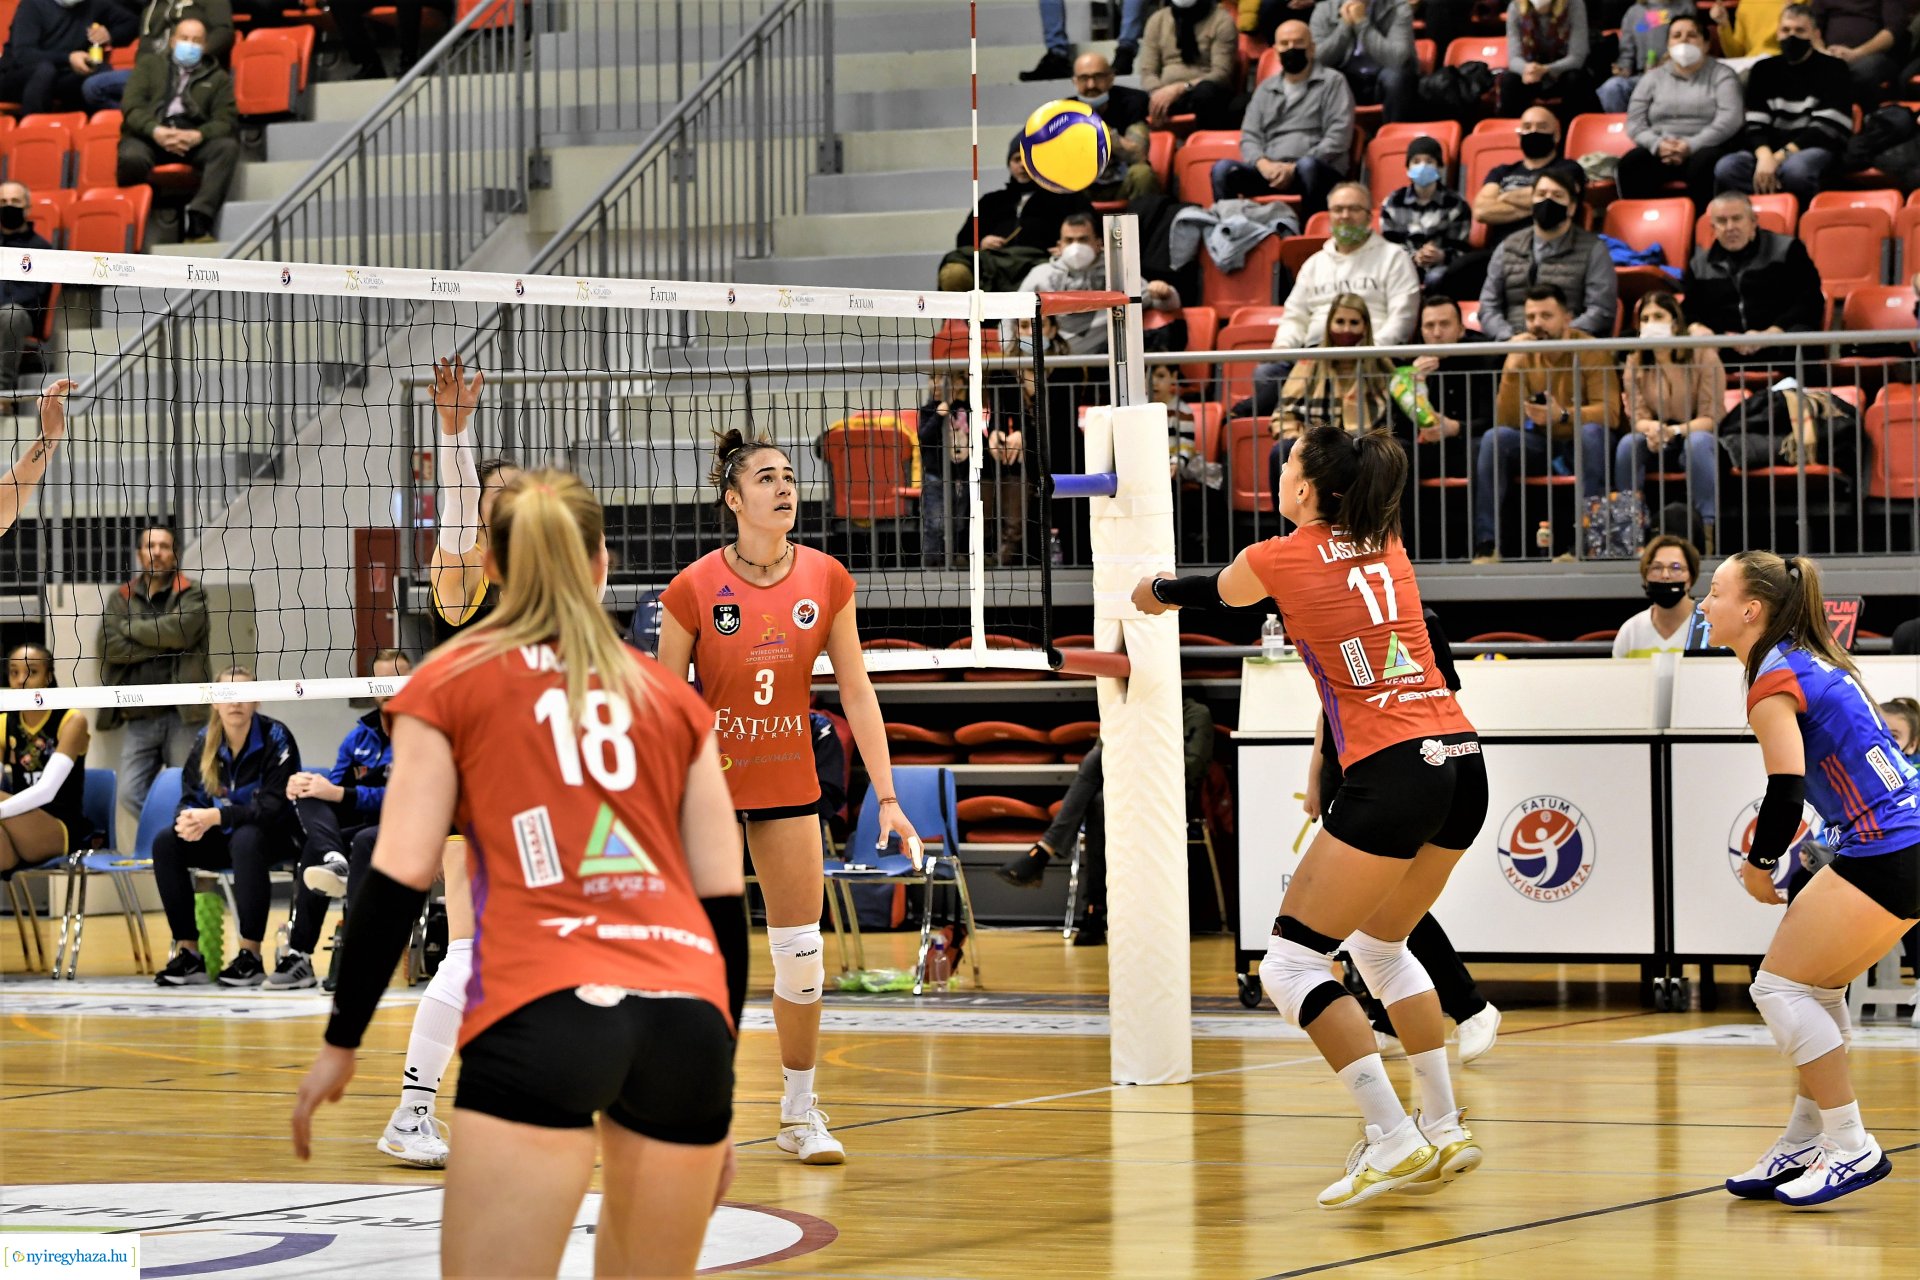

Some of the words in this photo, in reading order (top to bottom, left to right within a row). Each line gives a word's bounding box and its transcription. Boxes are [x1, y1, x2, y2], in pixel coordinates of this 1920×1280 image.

[187, 264, 220, 281] FATUM
[431, 277, 461, 293] FATUM
[650, 286, 677, 302] FATUM
[849, 294, 874, 309] FATUM
[1347, 561, 1398, 626] 17
[1823, 601, 1857, 613] TUM
[745, 653, 794, 663] SPORTCENTRUM
[1346, 641, 1369, 685] STRABAG
[368, 681, 394, 695] FATUM
[753, 668, 775, 706] 3
[115, 690, 144, 704] FATUM
[712, 707, 804, 736] FATUM
[534, 687, 637, 791] 18
[722, 731, 804, 742] ROPERTY
[1521, 798, 1570, 814] FATUM
